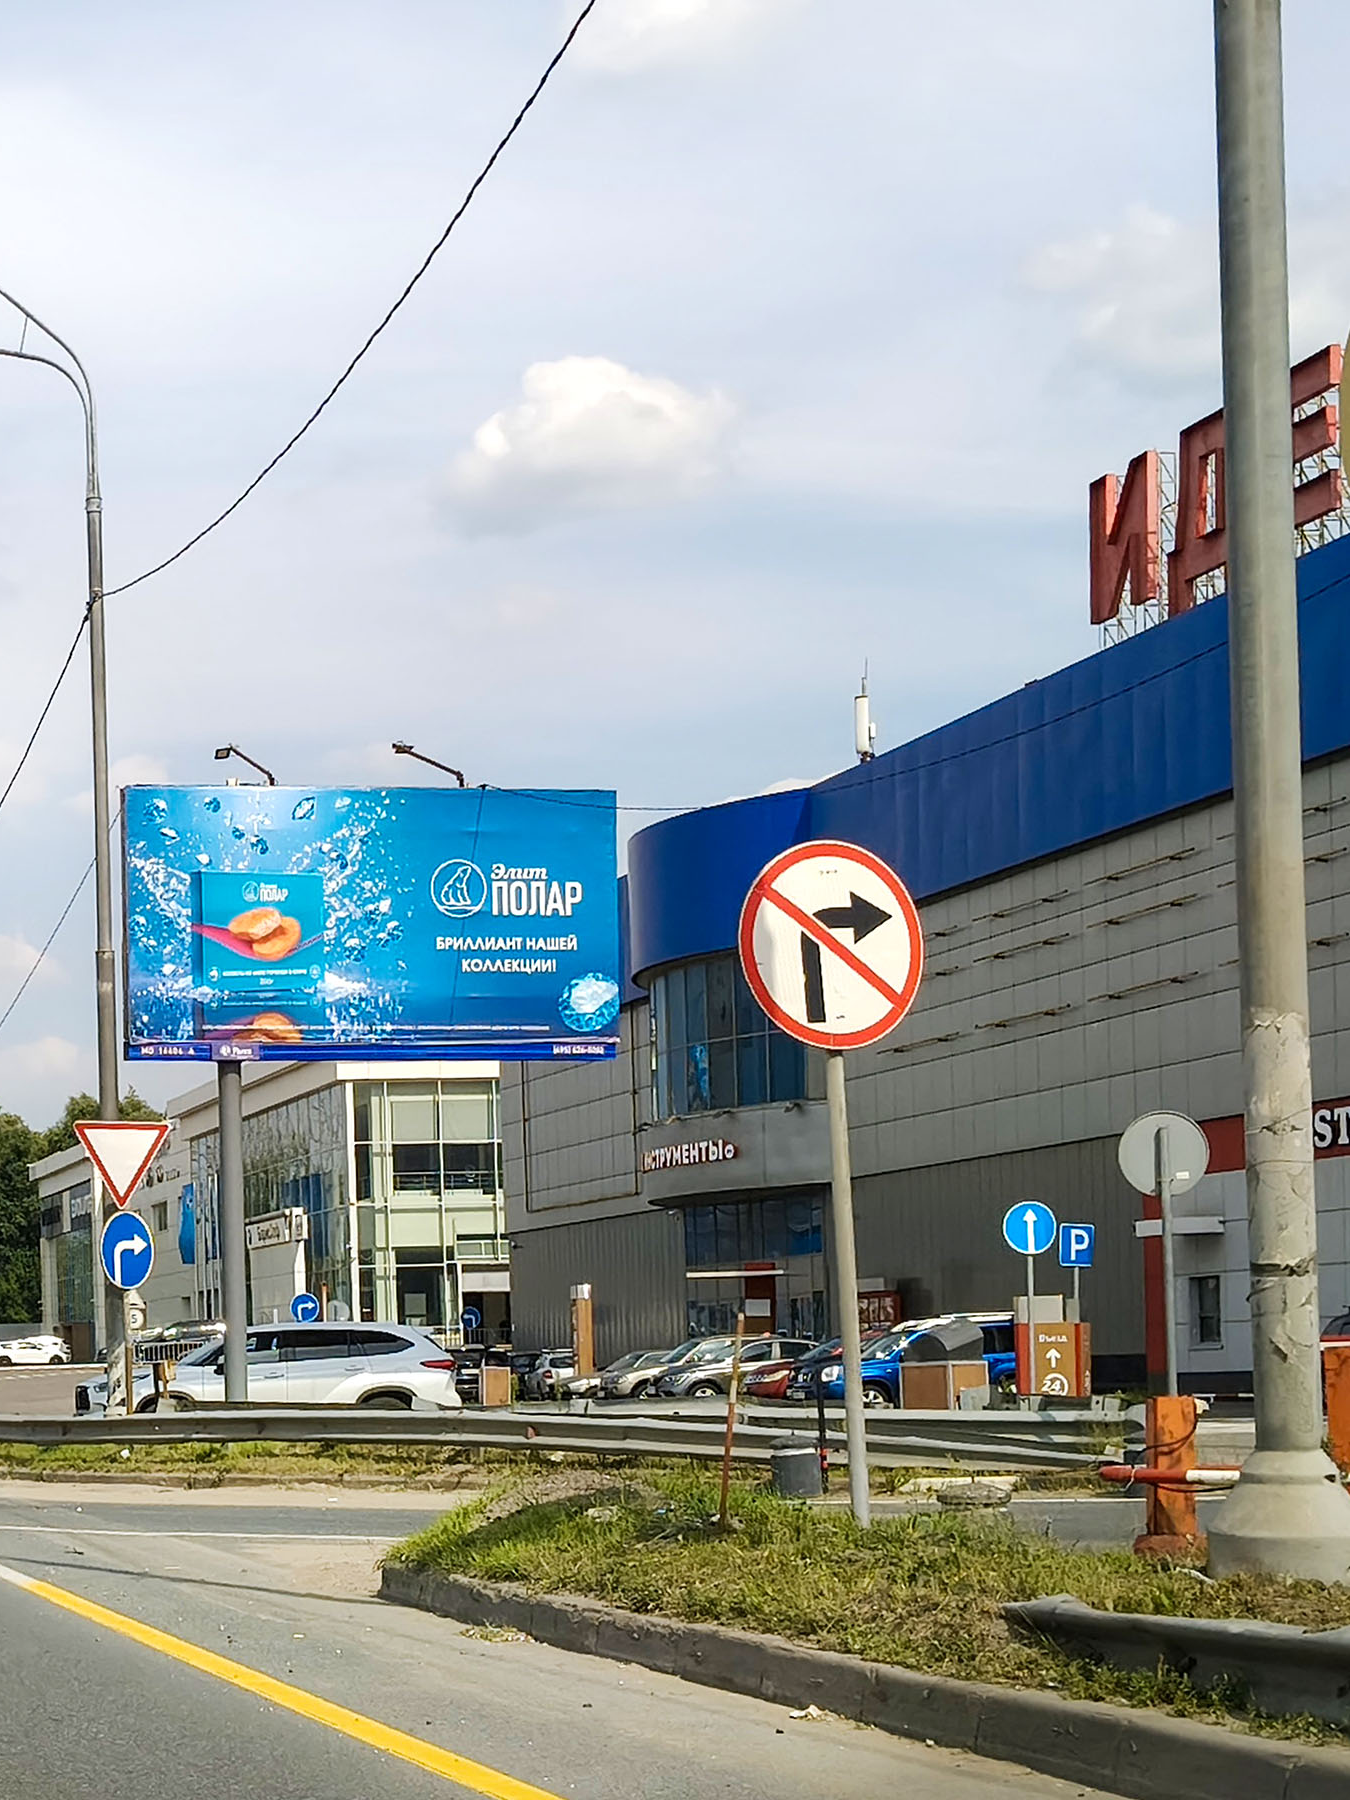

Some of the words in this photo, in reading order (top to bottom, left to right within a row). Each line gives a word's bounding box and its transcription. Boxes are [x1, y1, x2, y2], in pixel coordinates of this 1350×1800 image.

[1088, 326, 1350, 625] ИДЕ
[490, 863, 548, 880] Элит
[259, 888, 289, 902] ПОЛАР
[491, 881, 583, 917] ПОЛАР
[436, 936, 523, 951] БРИЛЛИАНТ
[526, 934, 578, 951] НАШЕЙ
[461, 958, 557, 975] КОЛЛЕКЦИИ!
[1070, 1228, 1089, 1261] P
[1041, 1379, 1063, 1393] 24
